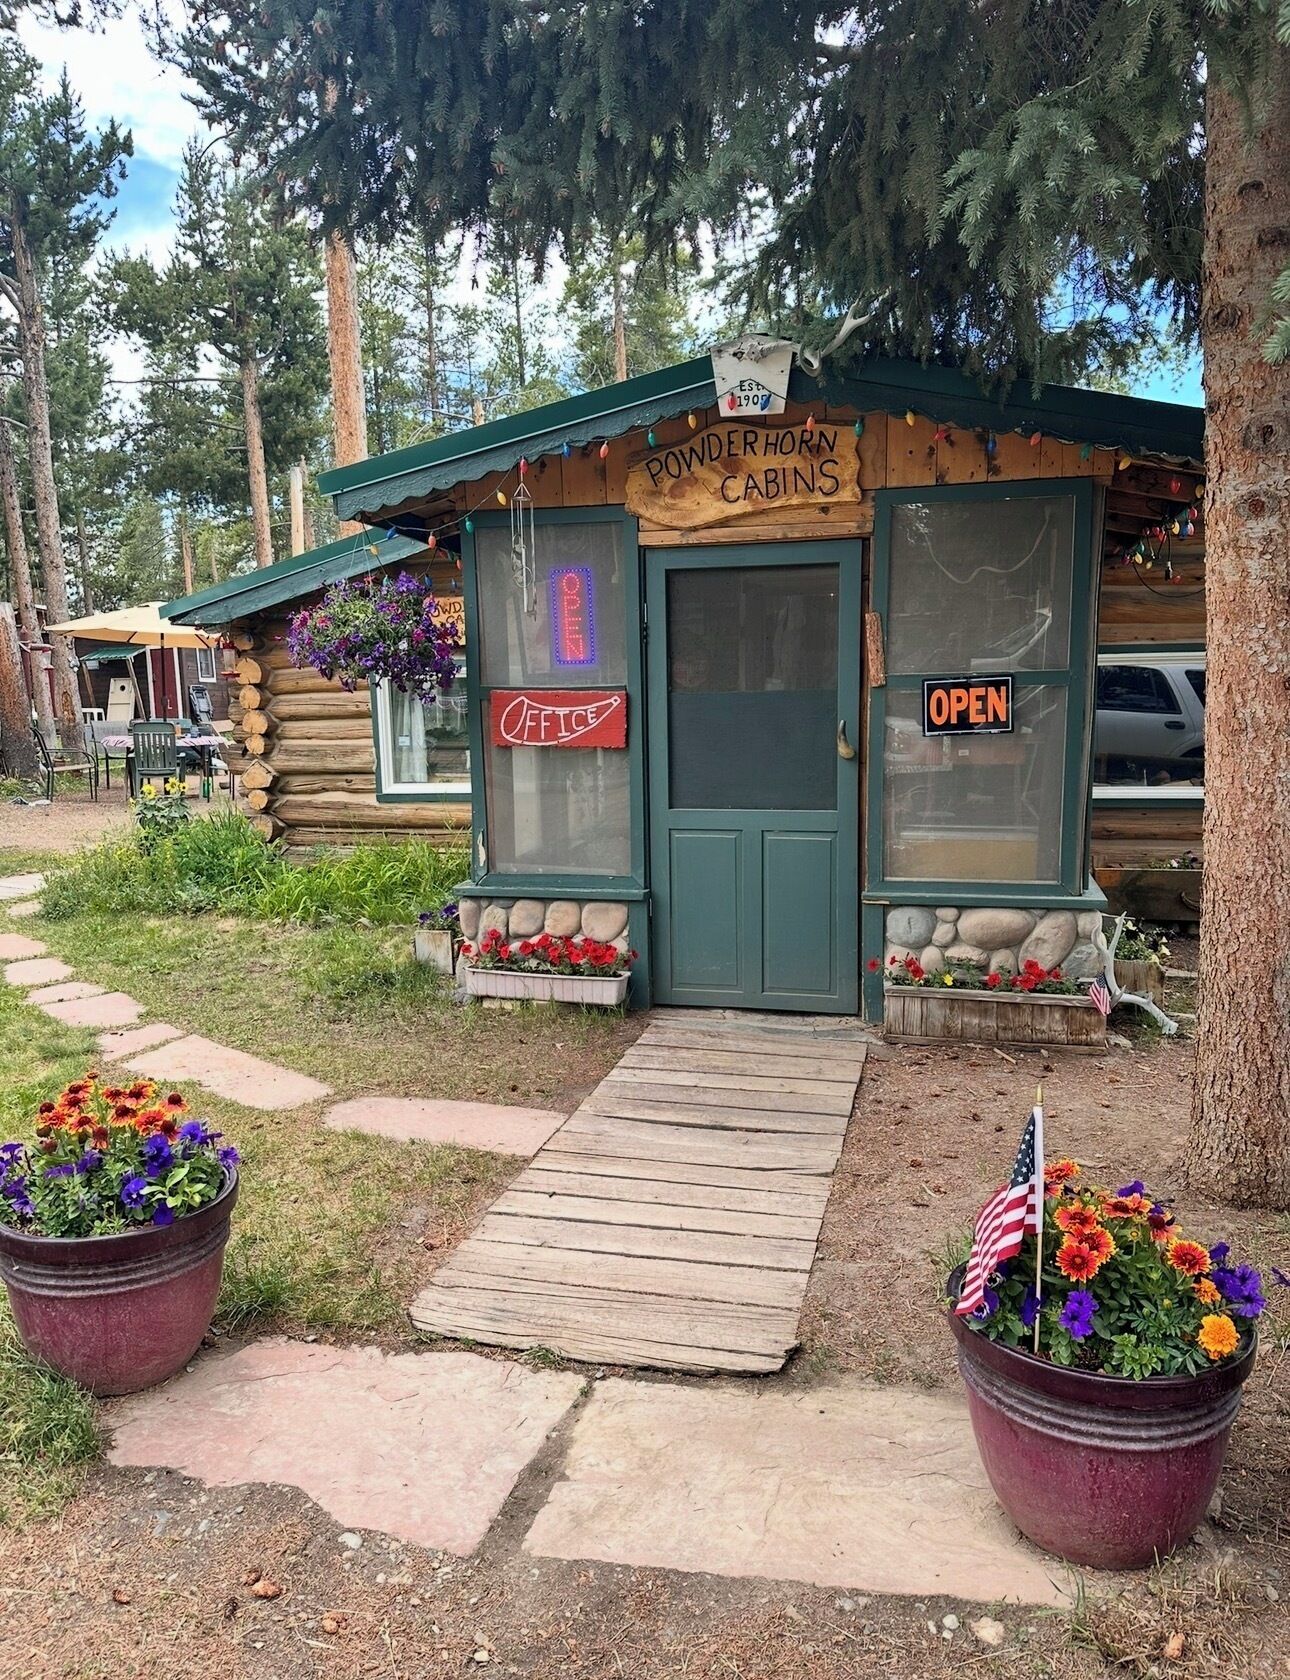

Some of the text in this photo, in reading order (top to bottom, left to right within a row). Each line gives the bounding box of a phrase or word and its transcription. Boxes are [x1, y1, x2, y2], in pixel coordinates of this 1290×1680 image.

[645, 429, 838, 488] POWDERHORN
[720, 459, 840, 503] CABINS
[561, 571, 585, 661] OPEN
[500, 695, 600, 742] OFFICE
[929, 686, 1007, 726] OPEN
